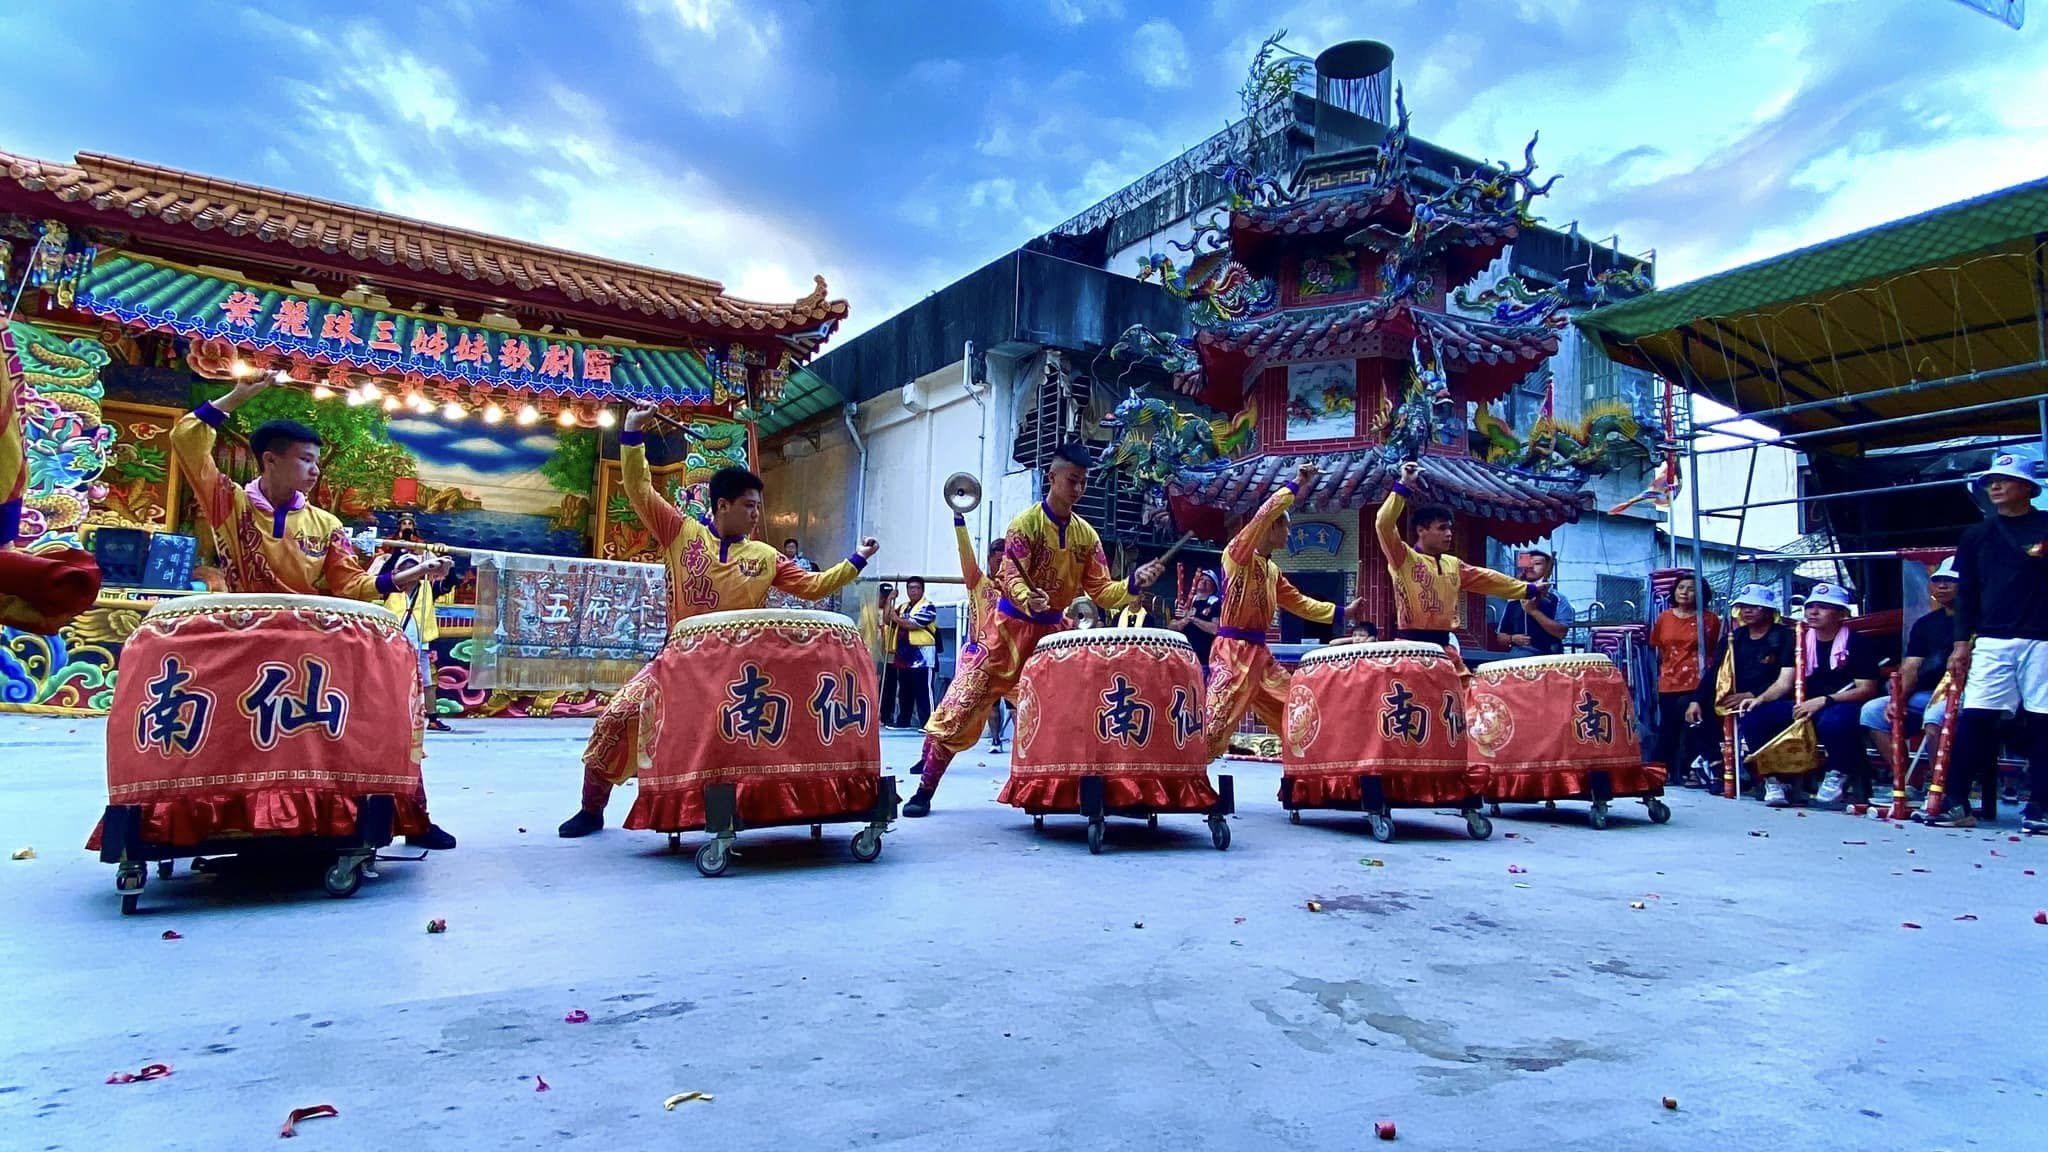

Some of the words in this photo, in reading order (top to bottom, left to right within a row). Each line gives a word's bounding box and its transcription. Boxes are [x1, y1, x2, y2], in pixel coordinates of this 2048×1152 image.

[682, 535, 719, 608] 南仙
[134, 653, 348, 757] 南仙
[719, 664, 869, 748] 南仙
[1096, 673, 1204, 748] 南仙
